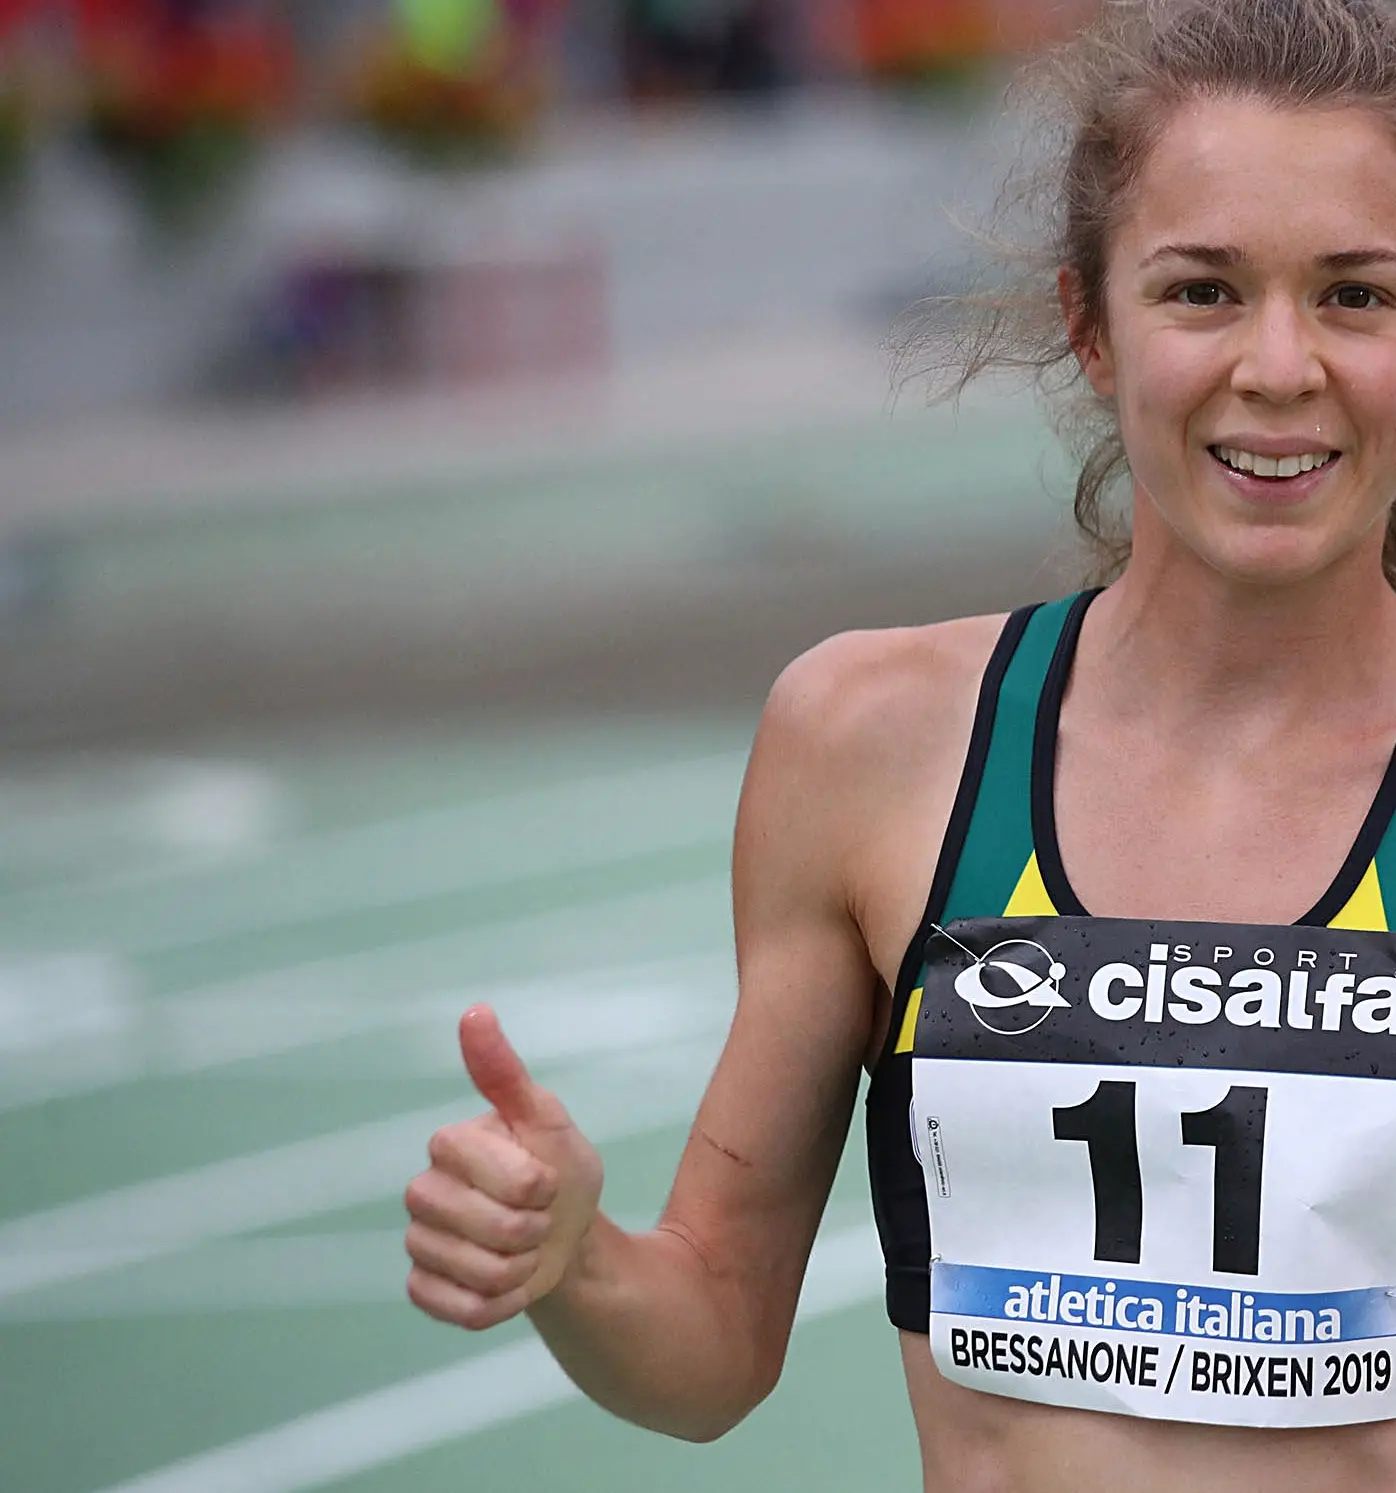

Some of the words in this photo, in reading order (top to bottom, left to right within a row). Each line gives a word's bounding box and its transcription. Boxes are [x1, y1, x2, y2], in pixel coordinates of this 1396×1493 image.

[1173, 945, 1358, 970] SPORT
[1052, 1080, 1269, 1275] 11
[1004, 1275, 1163, 1331] atletica
[1174, 1288, 1342, 1342] italiana
[951, 1328, 1160, 1388] BRESSANONE
[1164, 1344, 1186, 1394] /
[1191, 1352, 1314, 1397] BRIXEN
[1323, 1350, 1391, 1396] 2019
